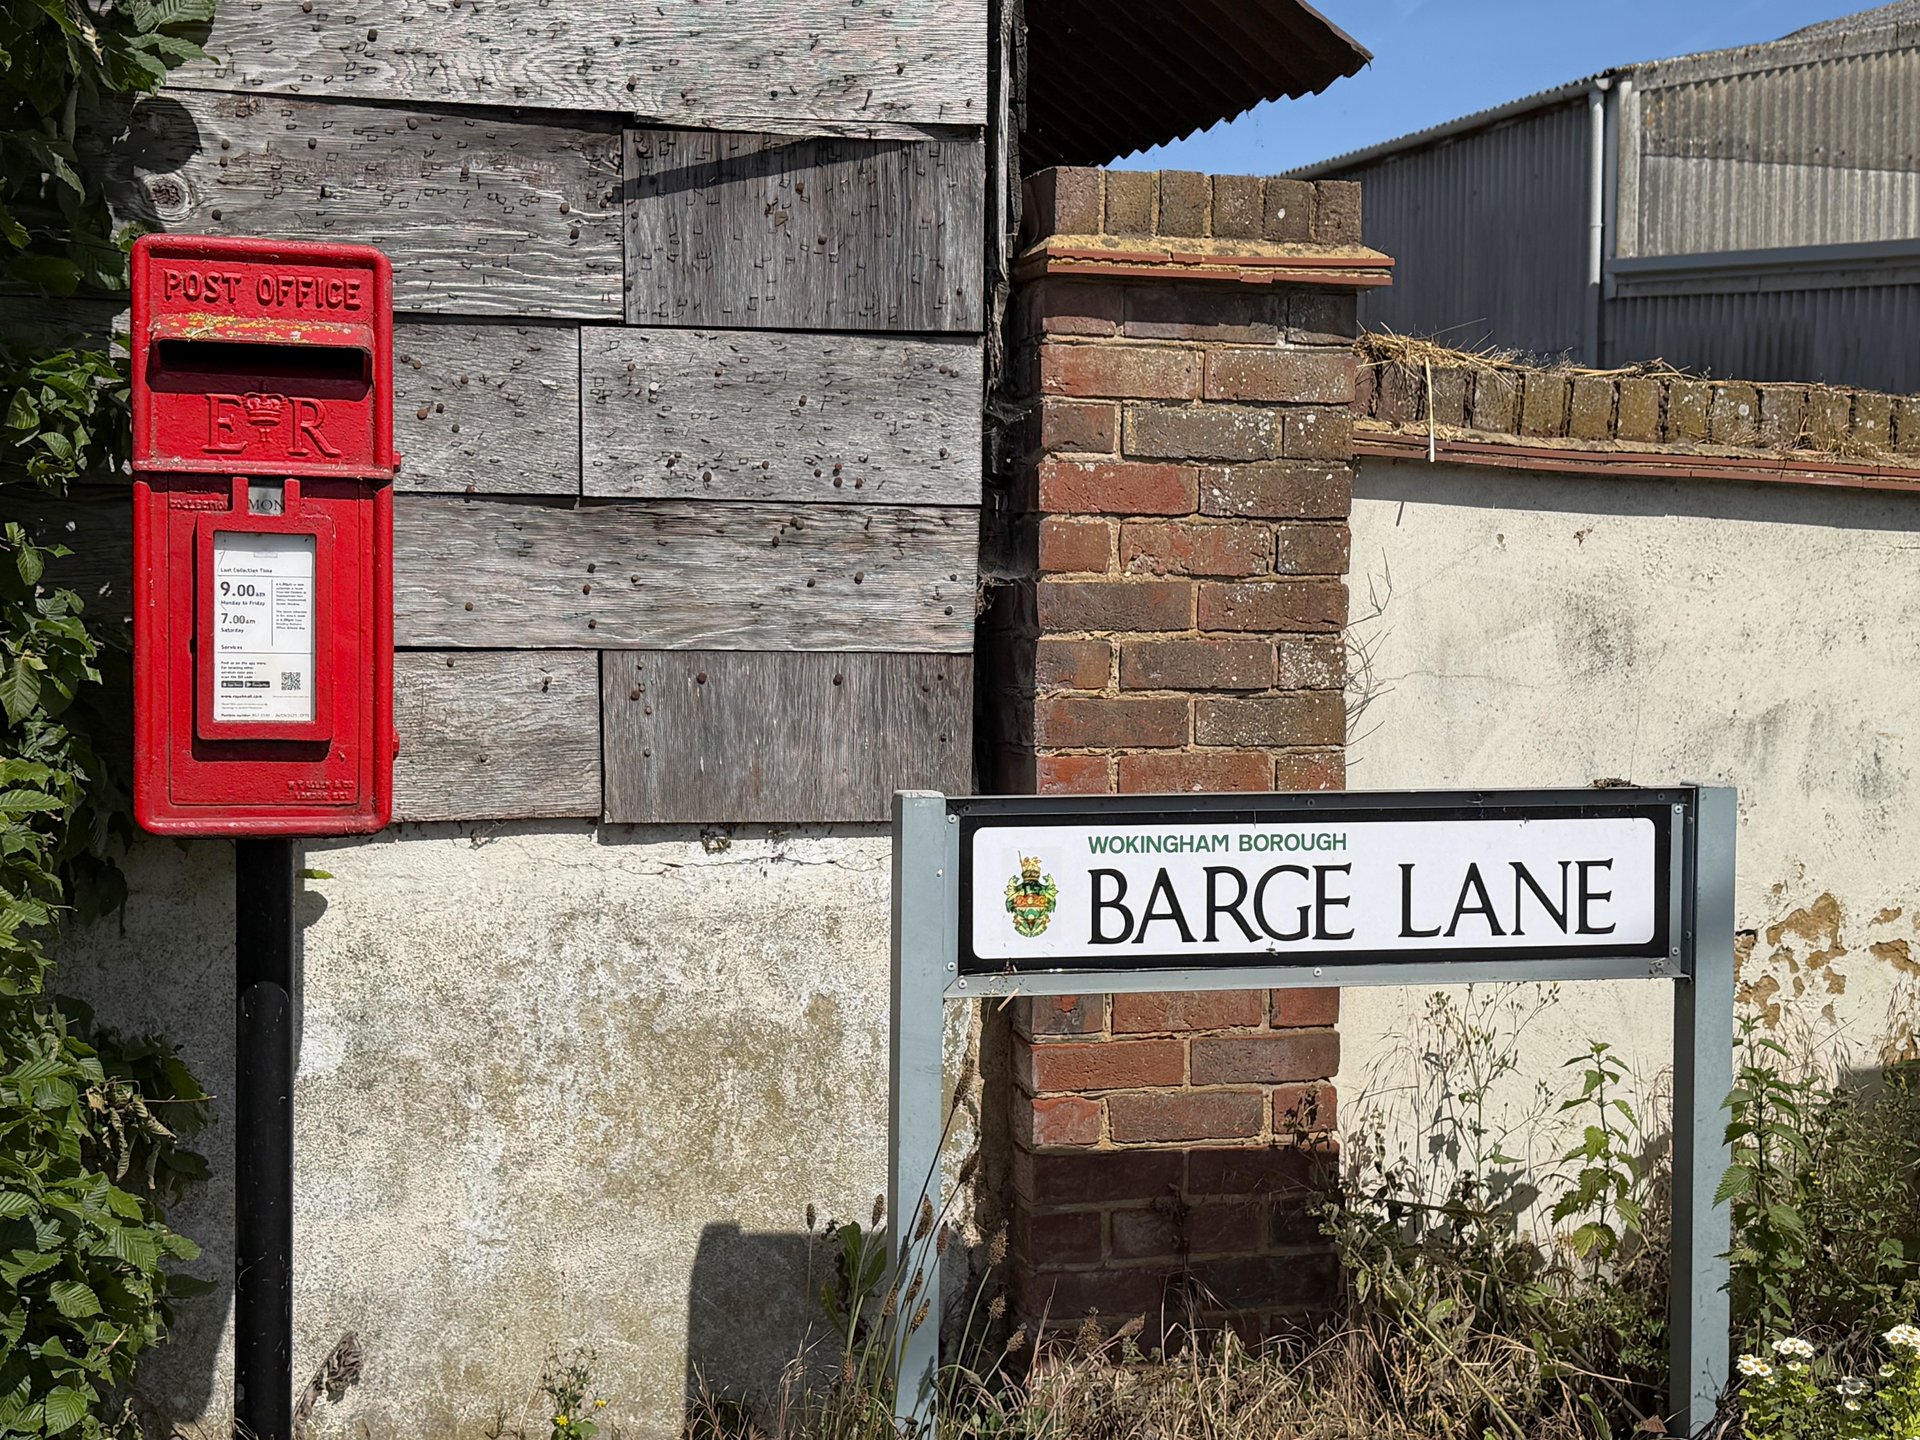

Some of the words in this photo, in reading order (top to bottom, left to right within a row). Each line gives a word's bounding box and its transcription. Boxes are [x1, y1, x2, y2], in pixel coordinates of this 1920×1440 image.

[163, 268, 242, 303] POST
[256, 272, 361, 310] OFFICE
[201, 393, 248, 454] E
[288, 397, 342, 458] R
[248, 498, 284, 511] MON
[1088, 834, 1229, 855] WOKINGHAM
[1239, 832, 1347, 852] BOROUGH
[1088, 862, 1355, 945] BARGE
[1398, 857, 1617, 938] LANE
